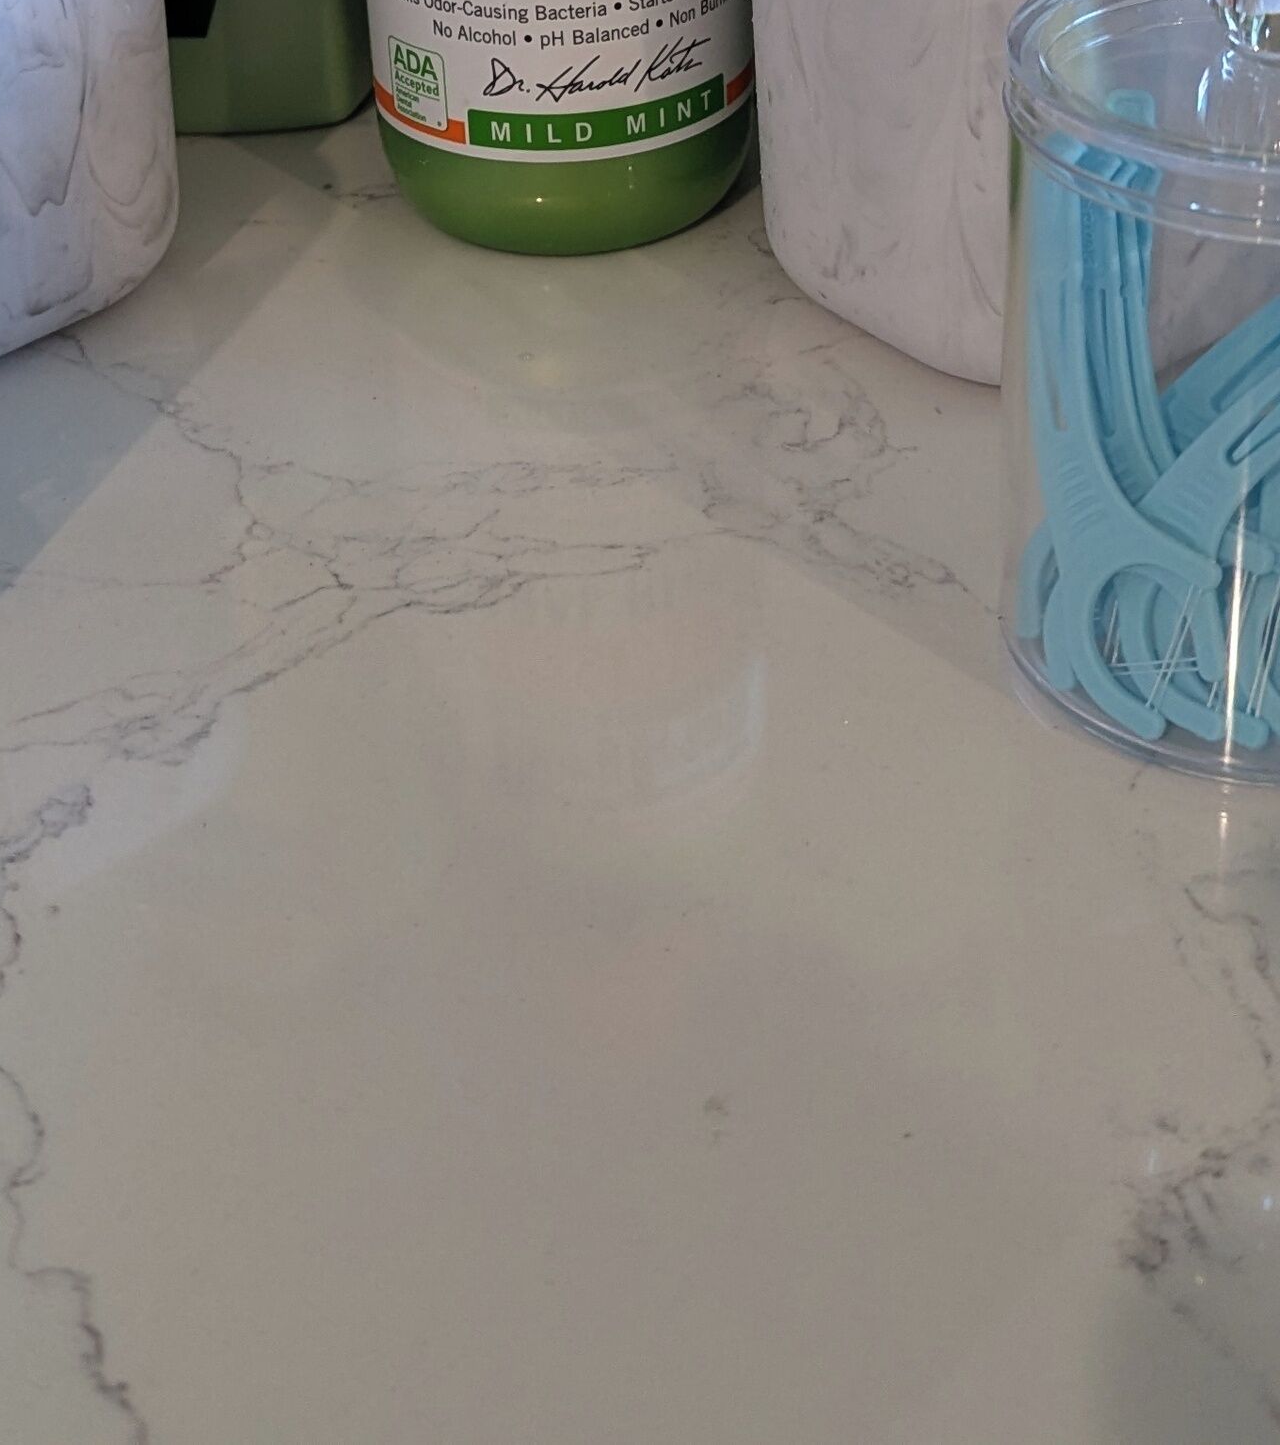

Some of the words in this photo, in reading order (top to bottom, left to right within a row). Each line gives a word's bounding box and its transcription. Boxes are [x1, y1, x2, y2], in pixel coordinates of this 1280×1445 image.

[433, 19, 452, 39] No
[458, 21, 517, 47] Alcohol
[539, 29, 565, 50] pH
[572, 20, 650, 46] Balanced
[669, 8, 696, 29] Non
[535, 3, 608, 21] Bacteria
[393, 43, 438, 81] ADA
[394, 70, 440, 96] Accepted
[490, 120, 593, 143] MILD
[627, 89, 712, 136] MINT
